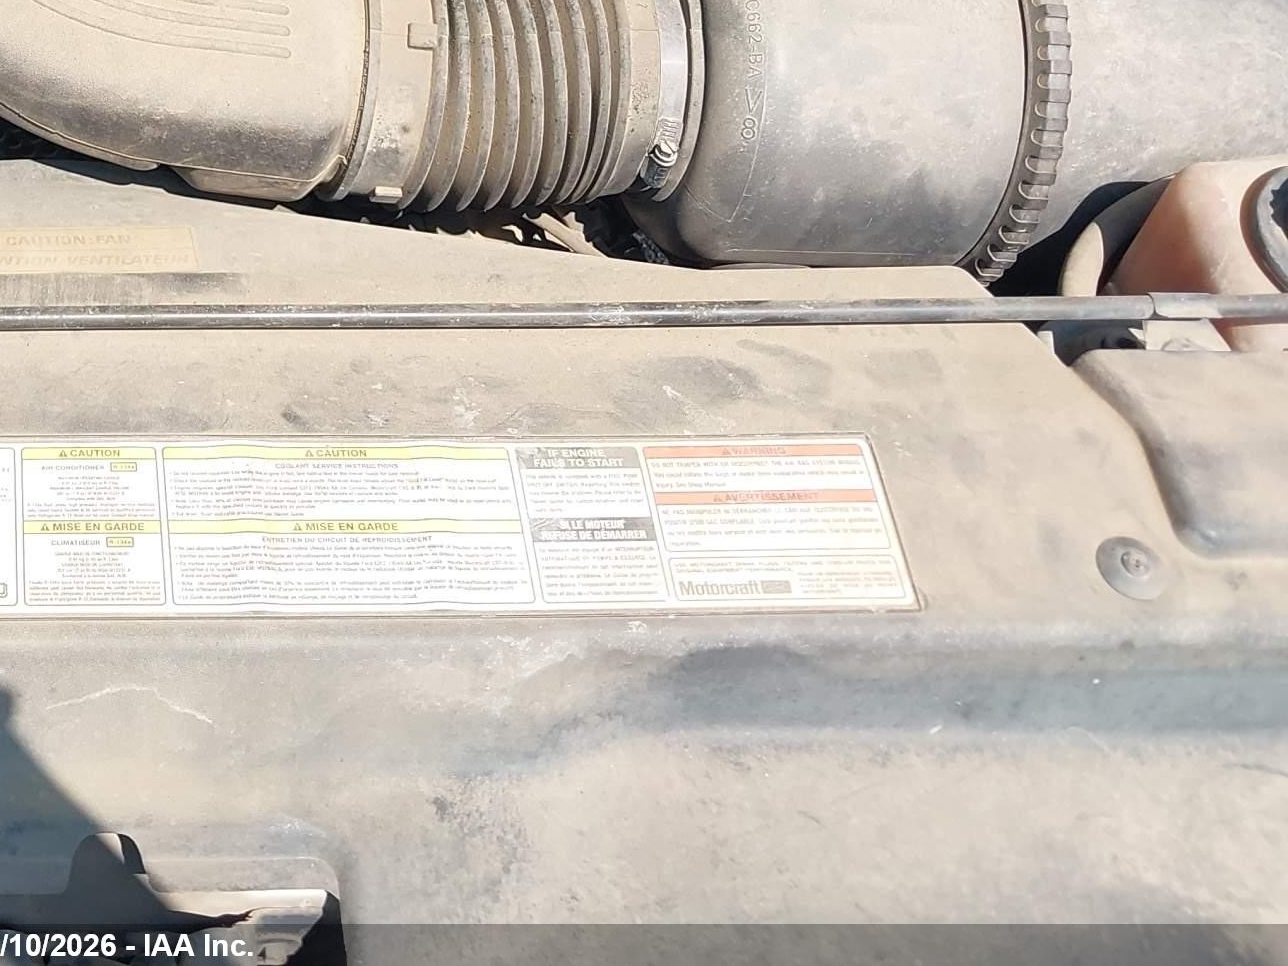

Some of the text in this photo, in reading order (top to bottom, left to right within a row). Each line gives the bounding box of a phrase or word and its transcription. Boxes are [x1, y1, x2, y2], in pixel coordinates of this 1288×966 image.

[95, 234, 131, 245] FAN
[69, 449, 121, 458] CAUTION
[315, 449, 368, 458] CAUTION
[547, 448, 607, 458] IF ENGINE
[568, 457, 586, 467] TO
[588, 457, 624, 467] START
[52, 522, 145, 531] MISE EN GARDE
[305, 522, 399, 531] MISE EN GARDE
[573, 520, 584, 529] LE
[678, 580, 761, 596] Motorcraft
